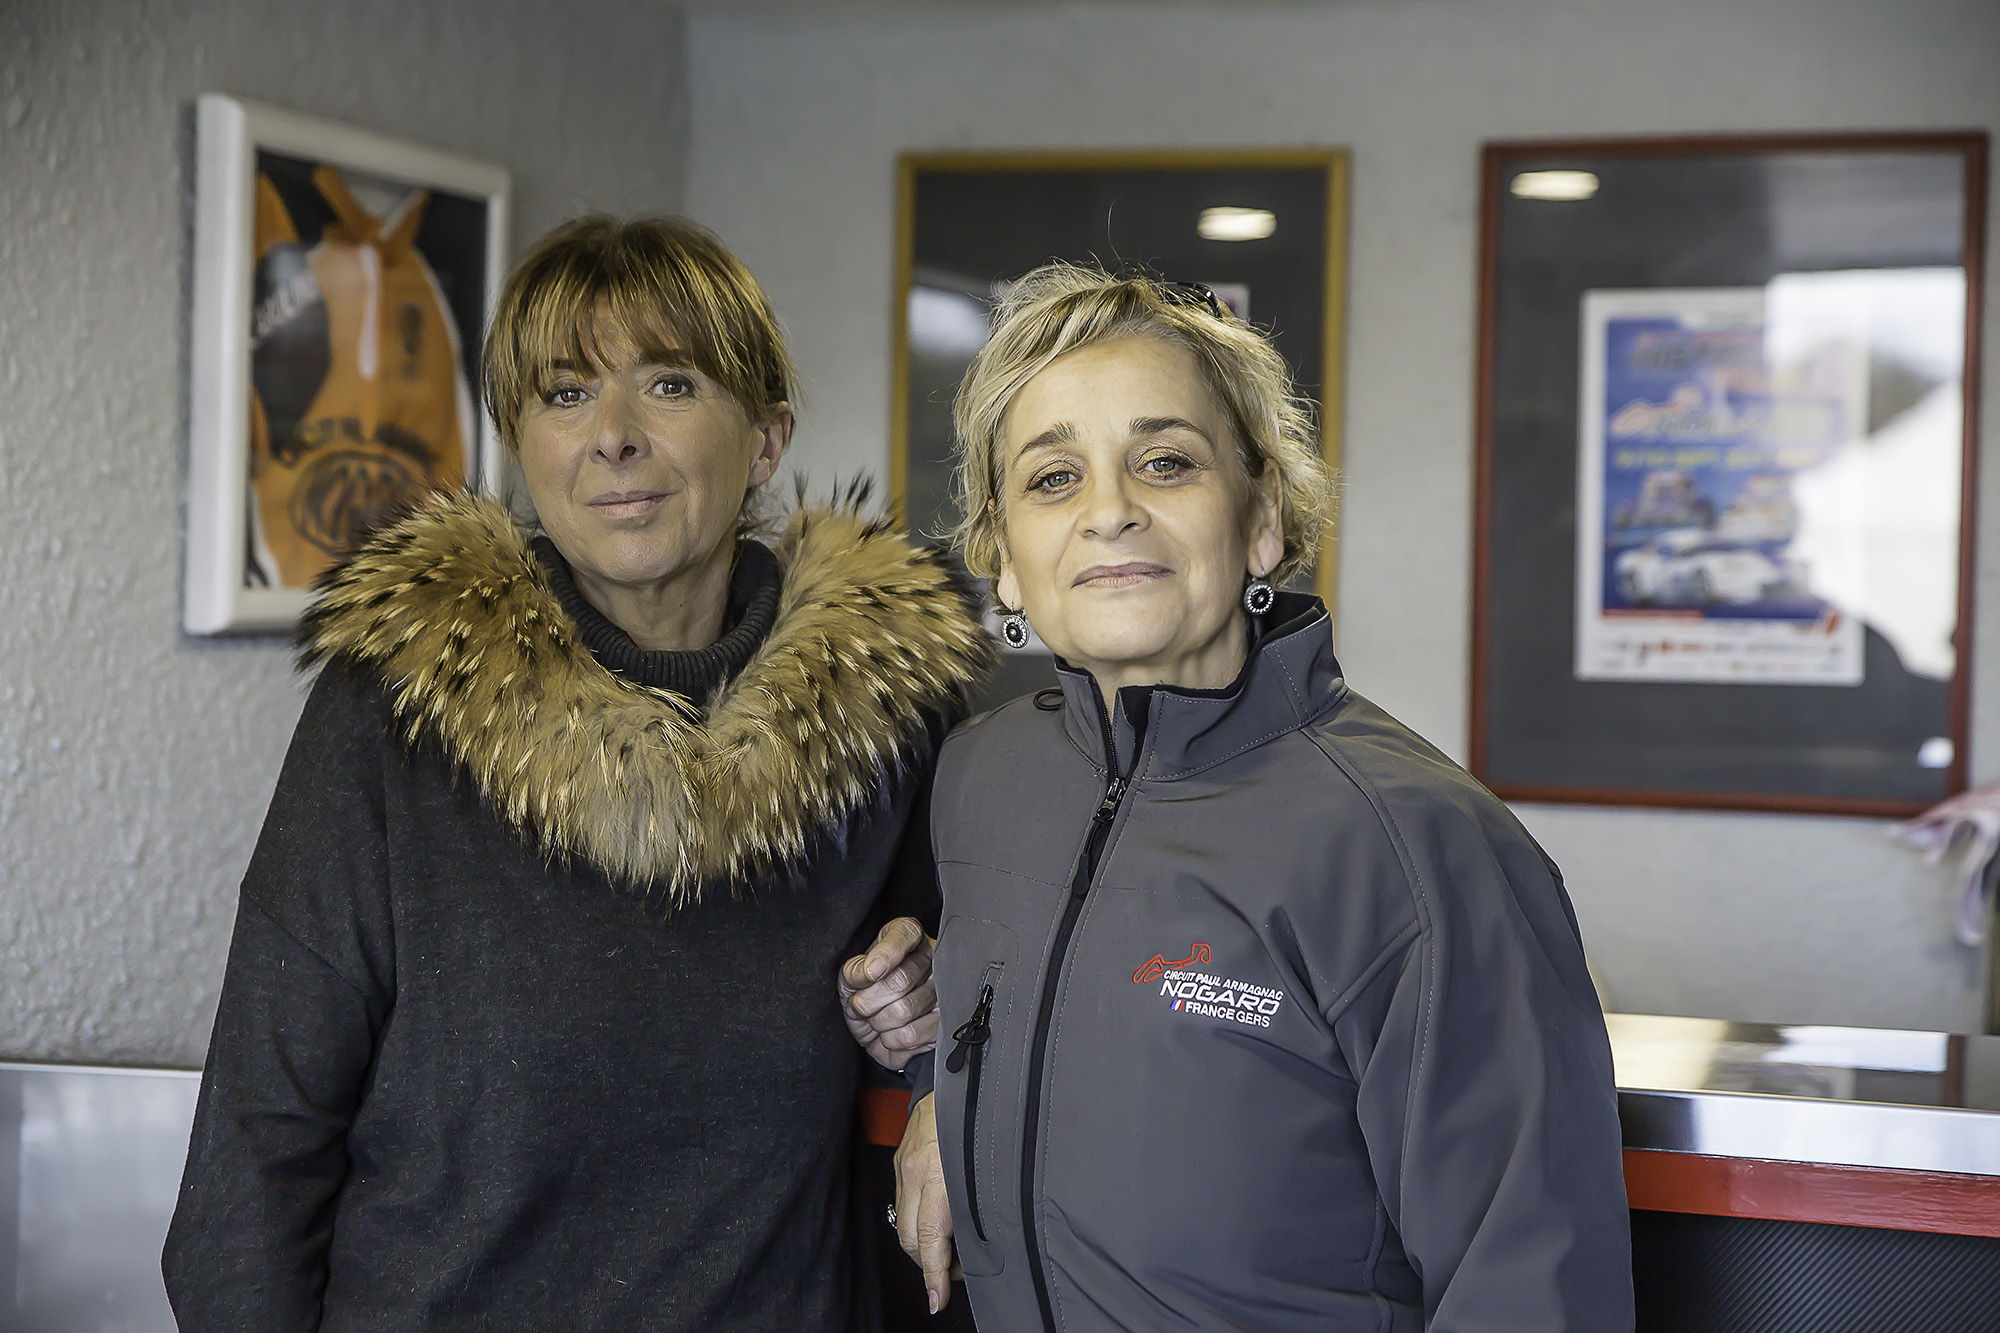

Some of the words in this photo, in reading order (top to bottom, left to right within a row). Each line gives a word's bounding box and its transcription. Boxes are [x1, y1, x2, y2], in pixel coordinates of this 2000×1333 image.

[1160, 980, 1280, 1016] NOGARO
[1164, 970, 1195, 982] CIRCUIT
[1195, 973, 1221, 987] PAUL
[1222, 979, 1283, 1001] ARMAGNAC
[1185, 1001, 1235, 1021] FRANCE
[1236, 1010, 1270, 1028] GERS
